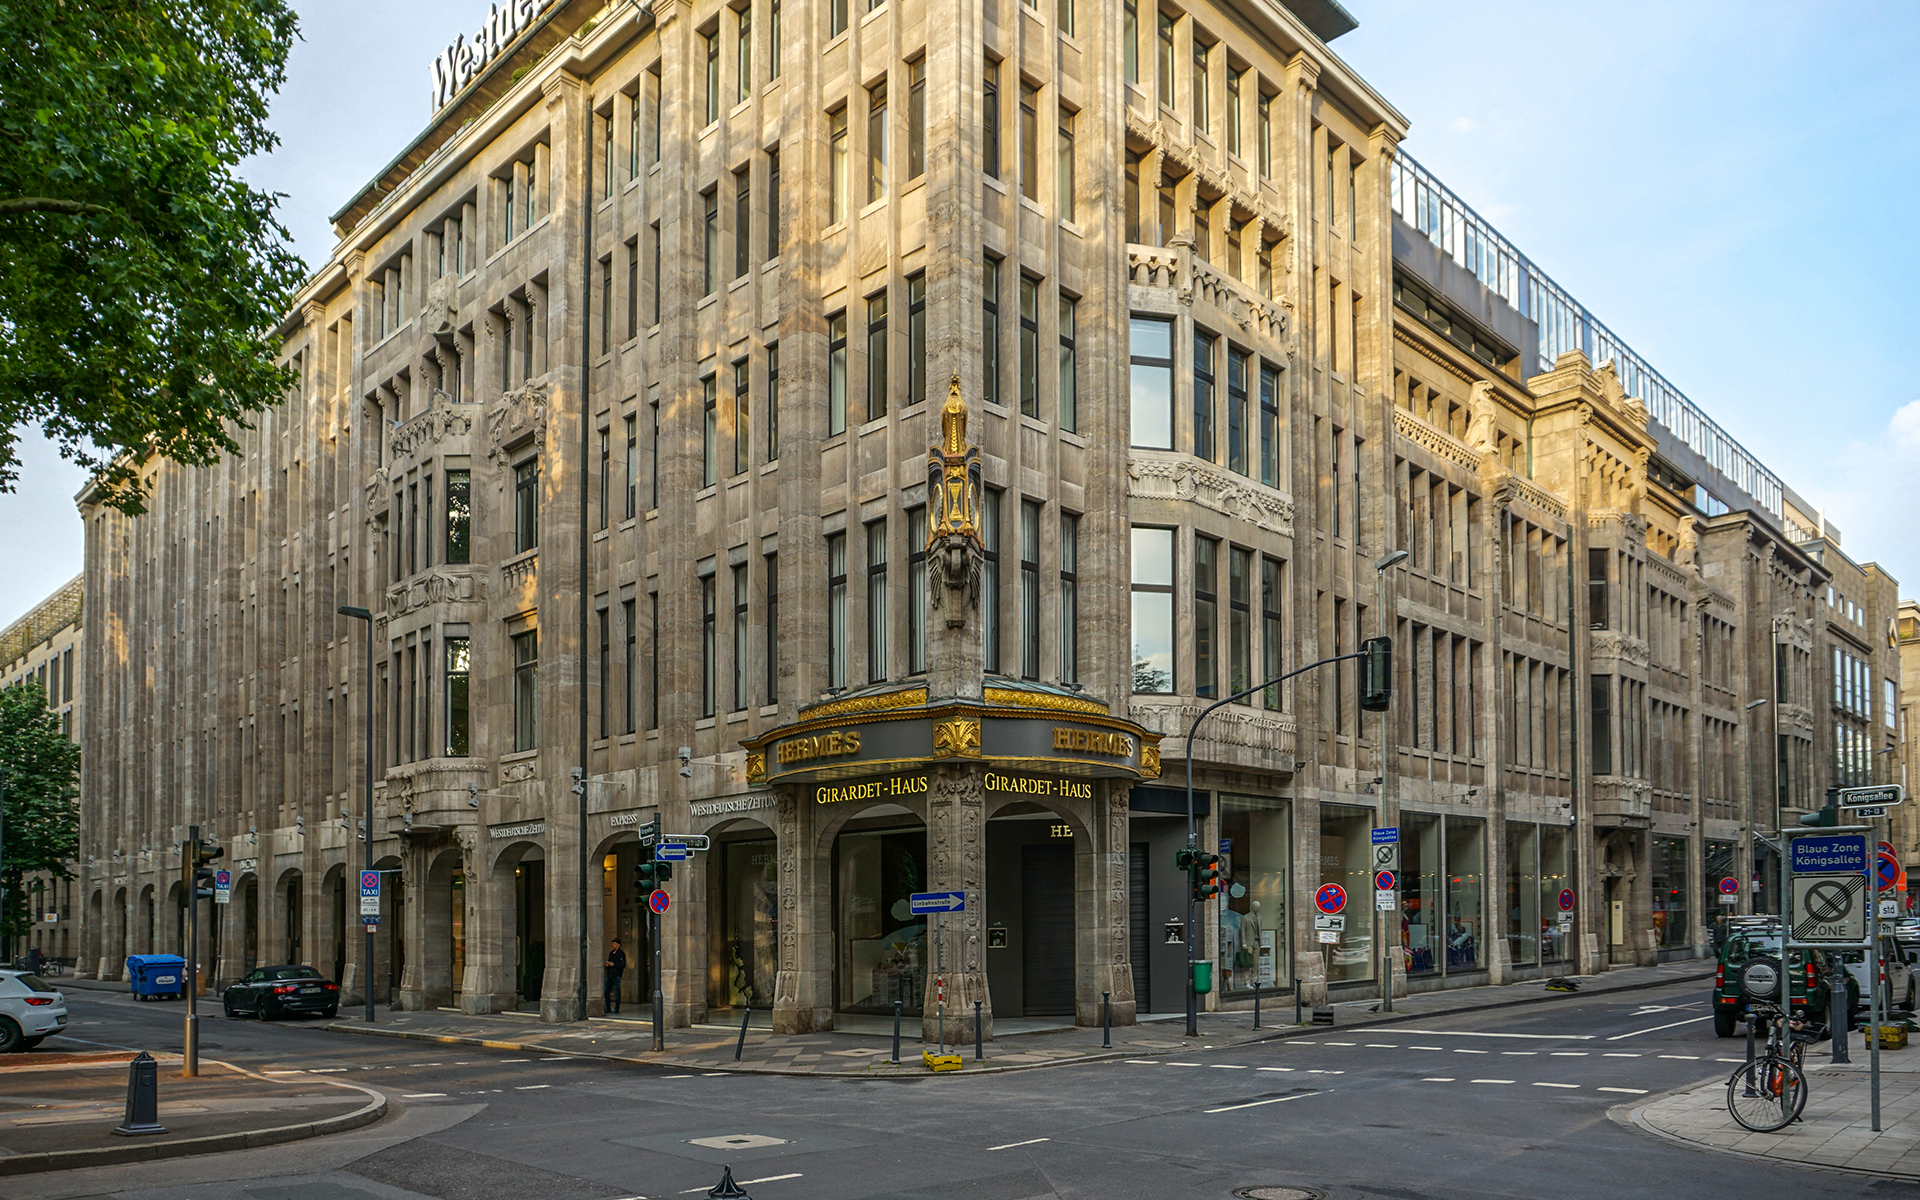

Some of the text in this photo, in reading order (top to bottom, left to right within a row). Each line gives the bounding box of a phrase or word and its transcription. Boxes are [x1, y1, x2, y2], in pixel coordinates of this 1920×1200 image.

[428, 0, 553, 108] Westde
[776, 730, 861, 764] HERMÈS
[1052, 727, 1134, 758] HERMÈS
[1847, 791, 1894, 804] Königsallee
[690, 798, 748, 816] WESTDEUTSCHE
[610, 813, 638, 827] EXPRESS
[1797, 843, 1860, 854] Blaue Zone
[1796, 855, 1862, 867] Königsallee
[362, 888, 378, 896] TAXI
[913, 899, 951, 907] Einbahnstraße
[1882, 904, 1895, 915] std
[1810, 925, 1847, 936] ZONE
